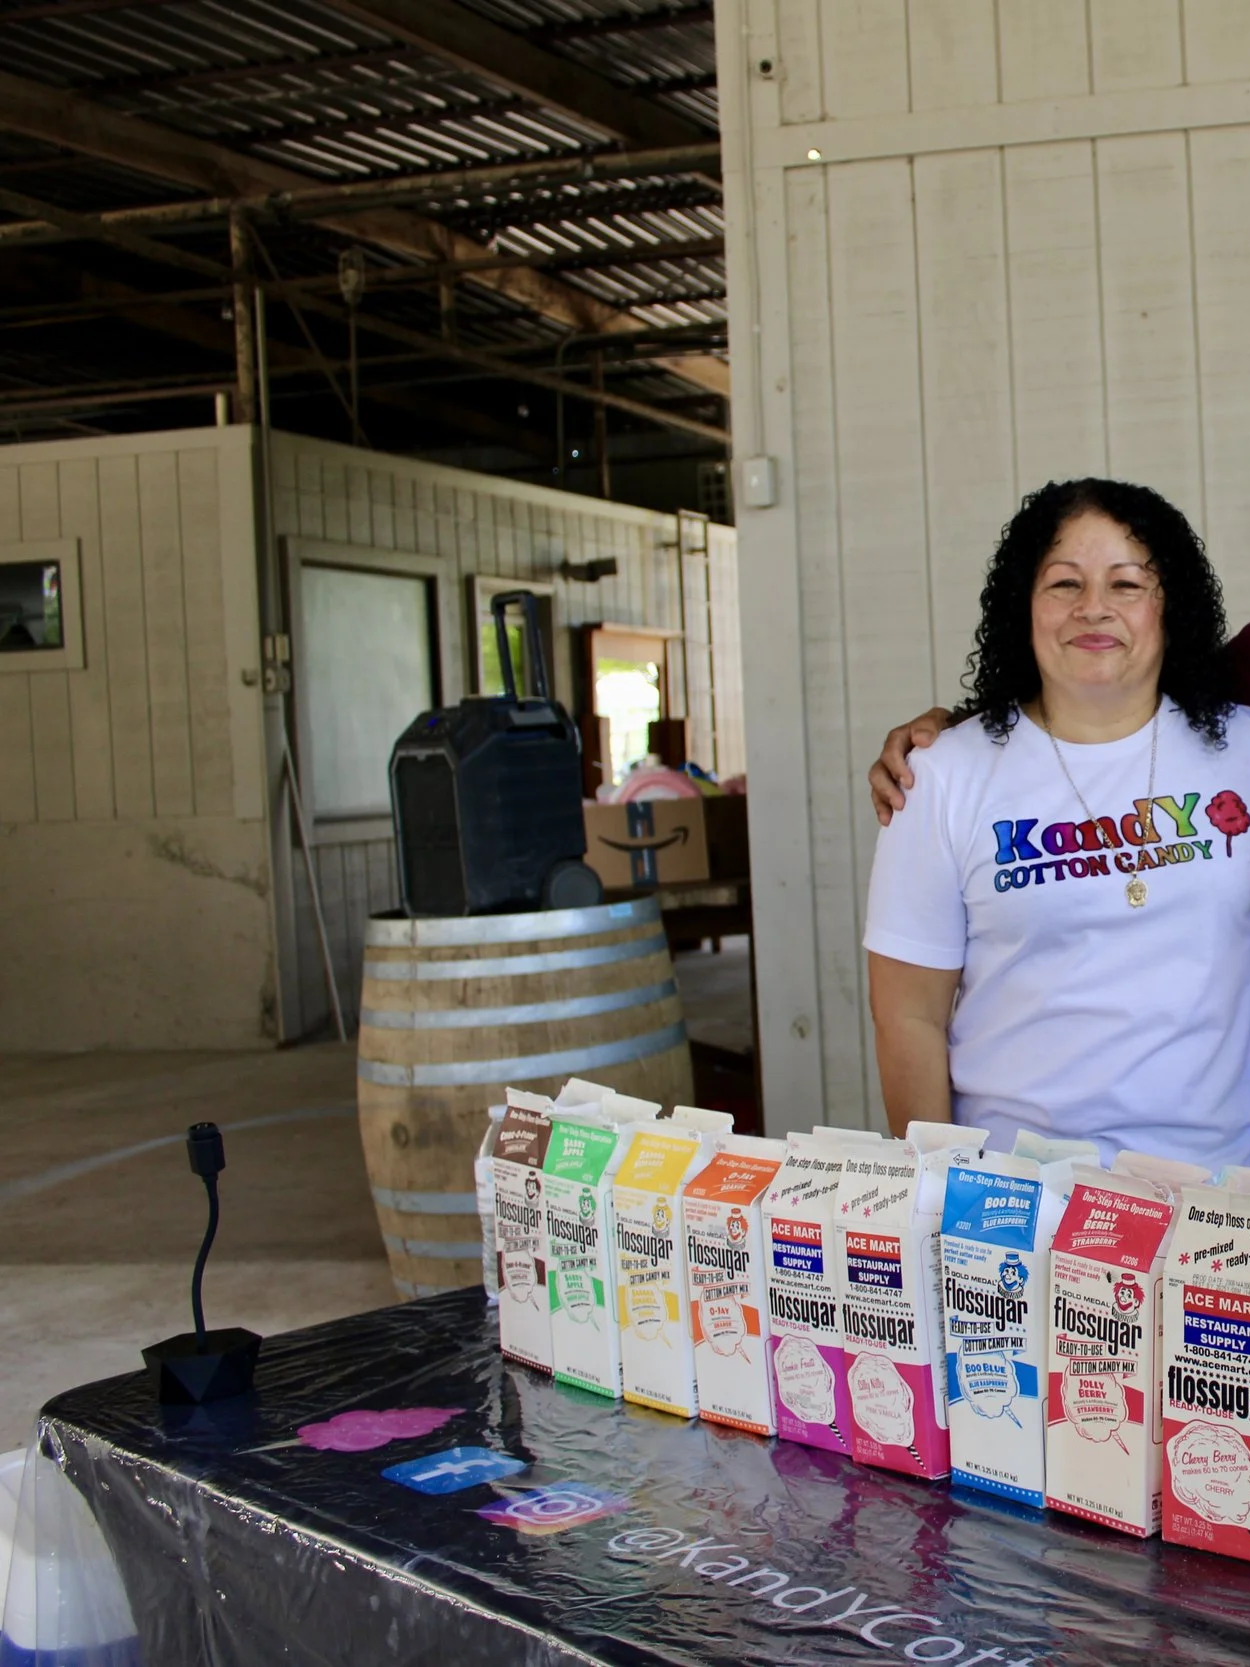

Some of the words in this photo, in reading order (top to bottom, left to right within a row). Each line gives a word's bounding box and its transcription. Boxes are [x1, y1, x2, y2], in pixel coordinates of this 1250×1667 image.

[994, 854, 1110, 892] COTTON
[1114, 840, 1213, 873] CANDY
[786, 1156, 798, 1167] One
[799, 1158, 811, 1169] step
[810, 1159, 825, 1170] floss
[846, 1160, 858, 1172] One
[859, 1162, 871, 1176] step
[873, 1164, 886, 1175] floss
[888, 1164, 914, 1179] operation
[781, 1179, 812, 1198] pre-mixed
[959, 1172, 993, 1187] One-Step
[994, 1178, 1009, 1189] Floss
[1010, 1181, 1034, 1192] Operation
[802, 1181, 839, 1201] ready-to-use
[851, 1186, 879, 1210] pre-mixed
[873, 1188, 908, 1213] ready-to-use
[985, 1197, 1006, 1209] BOO
[1008, 1197, 1030, 1209] BLUE
[1083, 1191, 1112, 1208] One-Step
[1113, 1199, 1130, 1211] Floss
[1131, 1203, 1162, 1219] Operation
[495, 1193, 542, 1235] flossugar
[1089, 1209, 1119, 1221] JOLLY
[1188, 1206, 1205, 1222] One
[1206, 1210, 1224, 1228] step
[1226, 1213, 1245, 1229] floss
[983, 1218, 996, 1228] BLUE
[1083, 1220, 1116, 1230] BERRY
[546, 1210, 598, 1253] flossugar
[772, 1223, 791, 1236] ACE
[794, 1224, 821, 1240] MART
[617, 1223, 673, 1267] flossugar
[773, 1243, 822, 1258] RESTAURANT
[847, 1237, 866, 1250] ACE
[870, 1238, 900, 1254] MART
[1072, 1239, 1117, 1247] STRAWBERRY
[688, 1236, 750, 1280] flossugar
[1194, 1239, 1234, 1263] pre-mixed
[783, 1257, 812, 1269] SUPPLY
[848, 1258, 901, 1273] RESTAURANT
[1121, 1255, 1138, 1266] #3206
[630, 1275, 644, 1284] COTTON
[646, 1272, 660, 1282] CANDY
[661, 1271, 670, 1279] MIX
[694, 1272, 724, 1283] READY-TO-USE
[774, 1268, 824, 1282] 1-800-841-4747
[859, 1272, 889, 1284] SUPPLY
[951, 1271, 969, 1280] GOLD
[971, 1276, 996, 1286] MEDAL
[1055, 1264, 1070, 1272] perfect
[1071, 1268, 1086, 1277] cotton
[1087, 1272, 1100, 1280] candy
[706, 1288, 722, 1299] COTTON
[723, 1286, 738, 1296] CANDY
[740, 1285, 748, 1293] MIX
[771, 1277, 831, 1292] www.acemart.com
[850, 1284, 902, 1298] 1-800-841-4747
[845, 1293, 911, 1309] www.acemart.com
[945, 1278, 1028, 1331] flossugar
[1062, 1290, 1081, 1300] GOLD
[1084, 1296, 1110, 1308] MEDAL
[1185, 1292, 1214, 1308] ACE
[710, 1307, 729, 1315] O-JAY
[770, 1287, 836, 1328] flossugar
[772, 1318, 810, 1332] READY-TO-USE
[842, 1303, 914, 1347] flossugar
[951, 1320, 991, 1334] READY-TO-USE
[1054, 1296, 1142, 1356] flossugar
[846, 1335, 887, 1349] READY-TO-USE
[965, 1339, 986, 1352] COTTON
[988, 1338, 1008, 1349] CANDY
[1011, 1338, 1023, 1348] MIX
[1059, 1341, 1103, 1356] READY-TO-USE
[1201, 1334, 1246, 1351] SUPPLY
[965, 1364, 982, 1373] BOO
[983, 1364, 1005, 1373] BLUE
[1072, 1362, 1097, 1374] COTTON
[1099, 1360, 1120, 1372] CANDY
[1122, 1362, 1135, 1372] MIX
[1080, 1379, 1104, 1389] JOLLY
[1078, 1390, 1107, 1399] BERRY
[1077, 1406, 1114, 1414] STRAWBERRY
[1170, 1400, 1234, 1420] READY-TO-USE
[1182, 1451, 1208, 1466] Cherry
[1213, 1450, 1236, 1464] Berry
[1205, 1484, 1234, 1496] CHERRY
[1086, 1499, 1095, 1508] 3.25
[1096, 1502, 1102, 1510] LB
[1115, 1509, 1123, 1518] kg)
